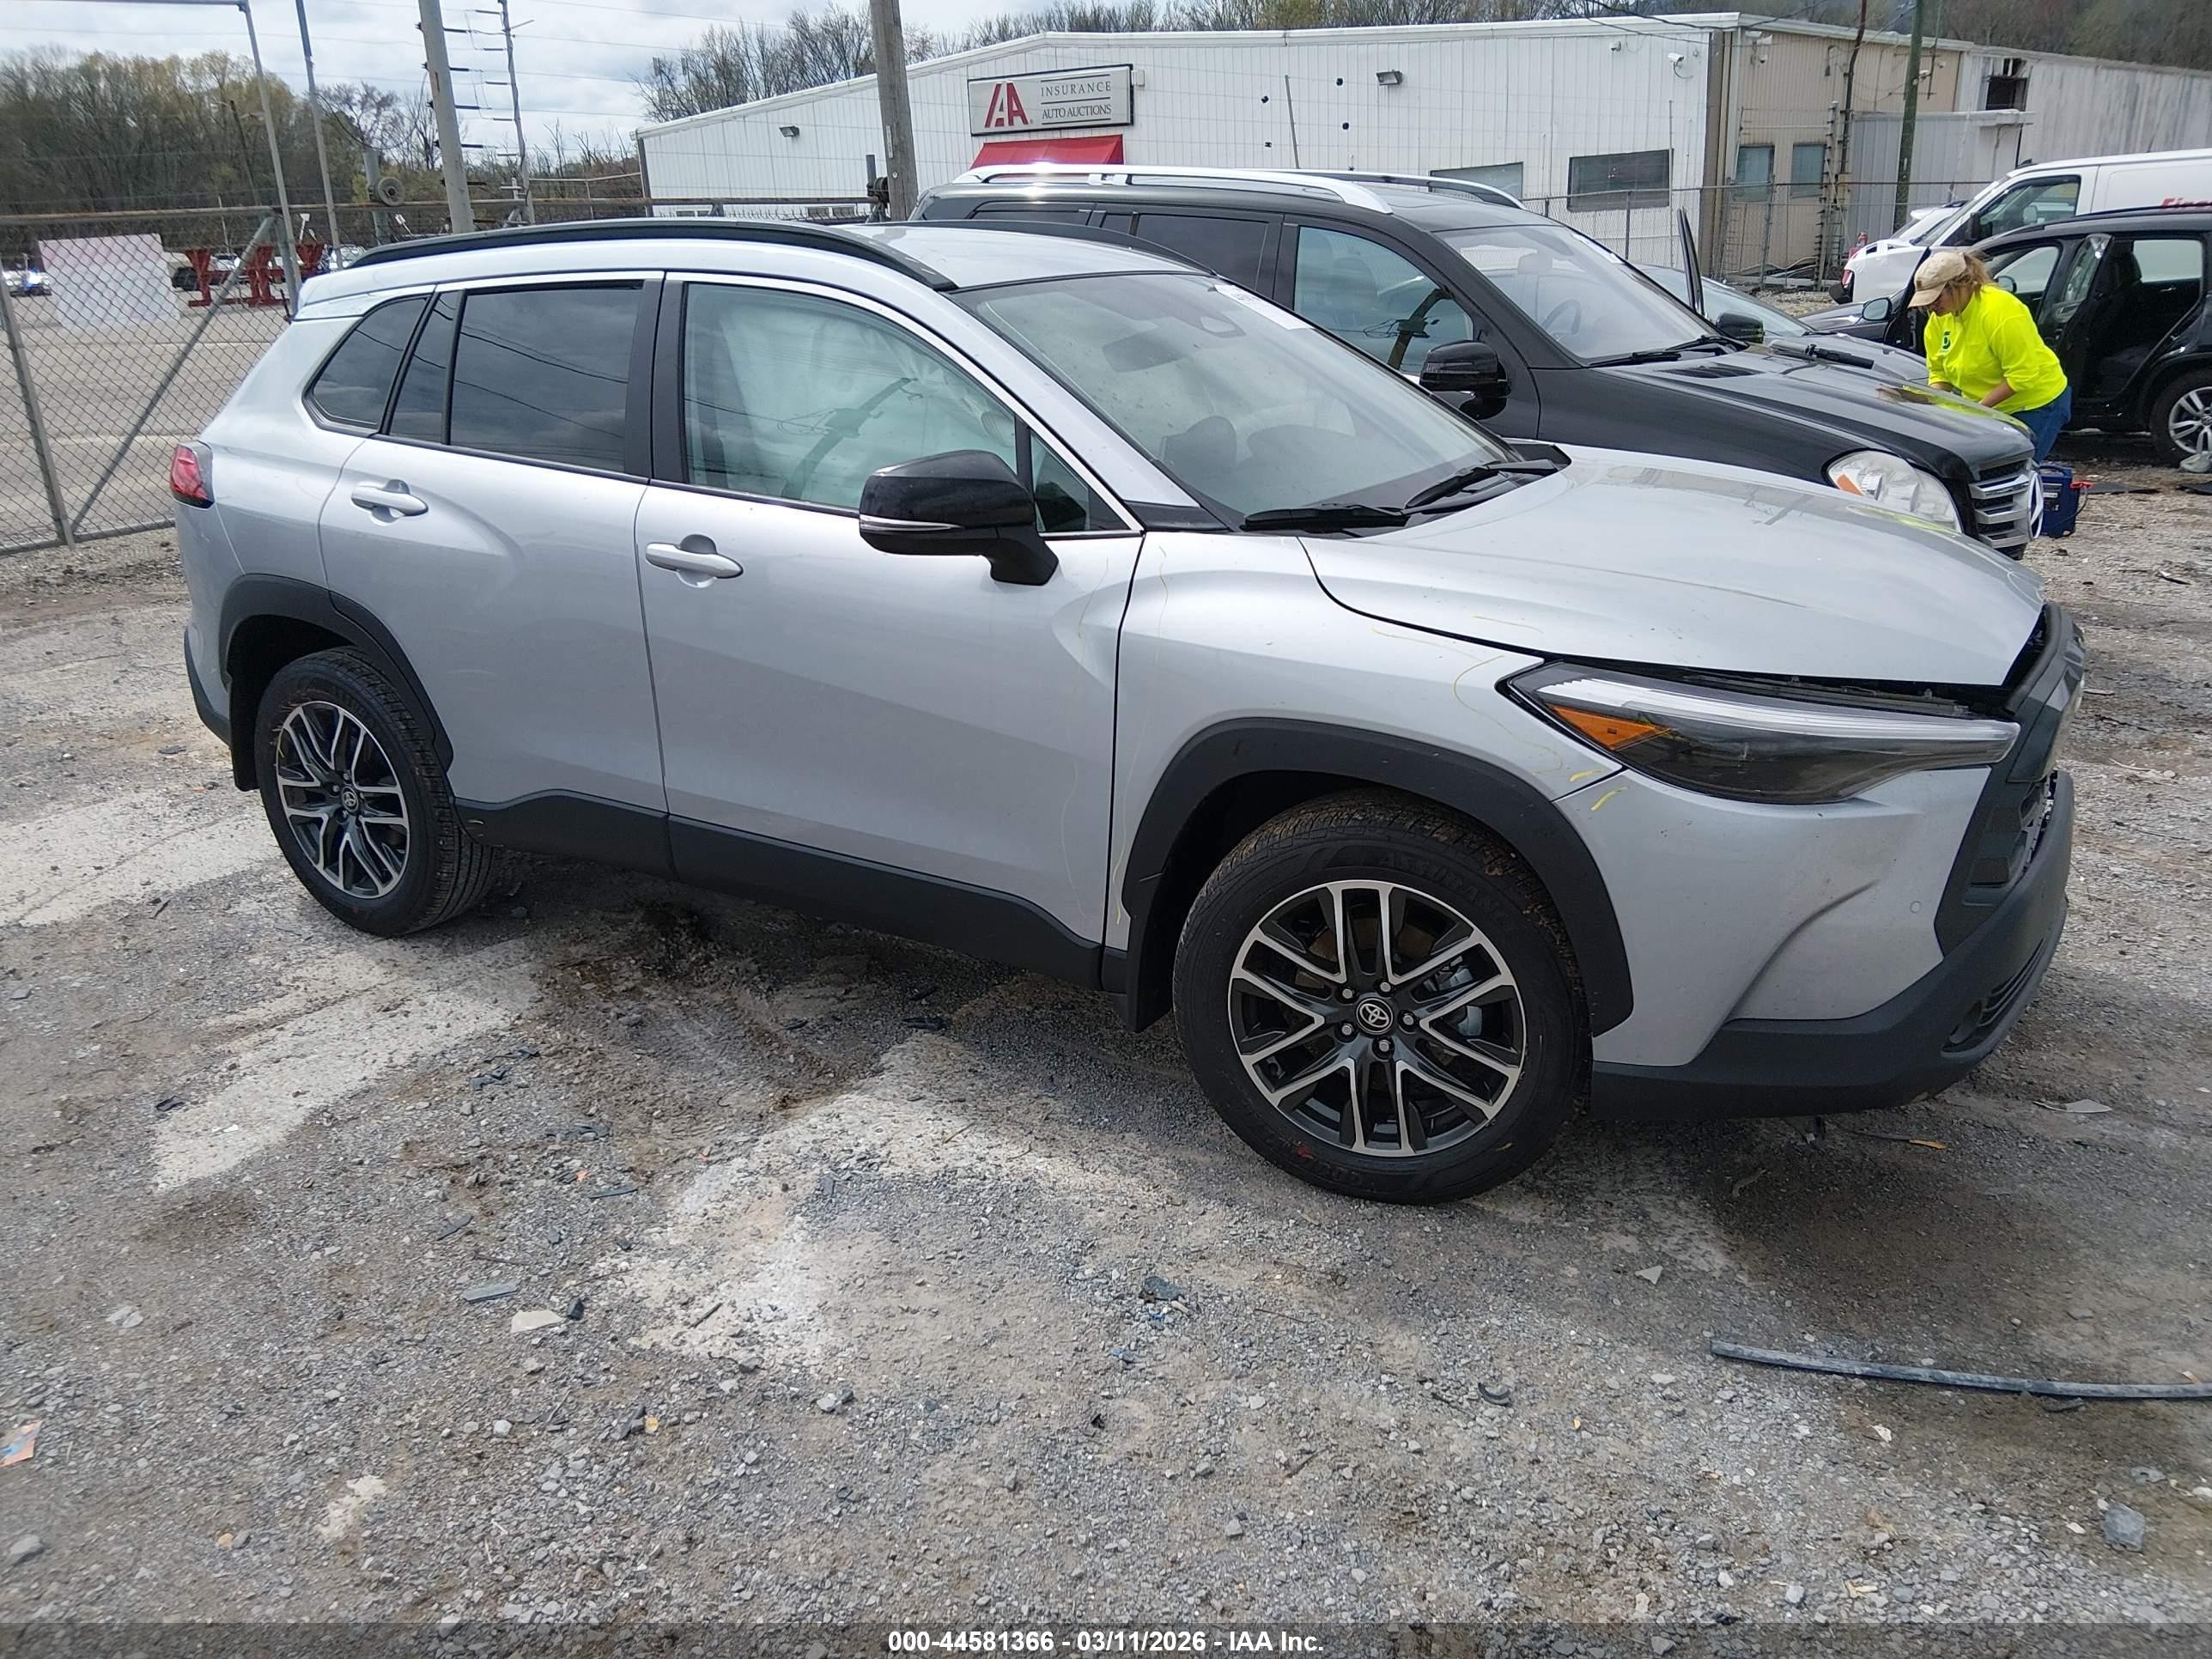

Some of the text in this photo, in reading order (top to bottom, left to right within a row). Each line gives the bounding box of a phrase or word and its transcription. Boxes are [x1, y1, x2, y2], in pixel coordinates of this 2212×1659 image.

[1041, 81, 1111, 97] INSURANCE
[1042, 104, 1112, 120] AUTO AUCTIONS
